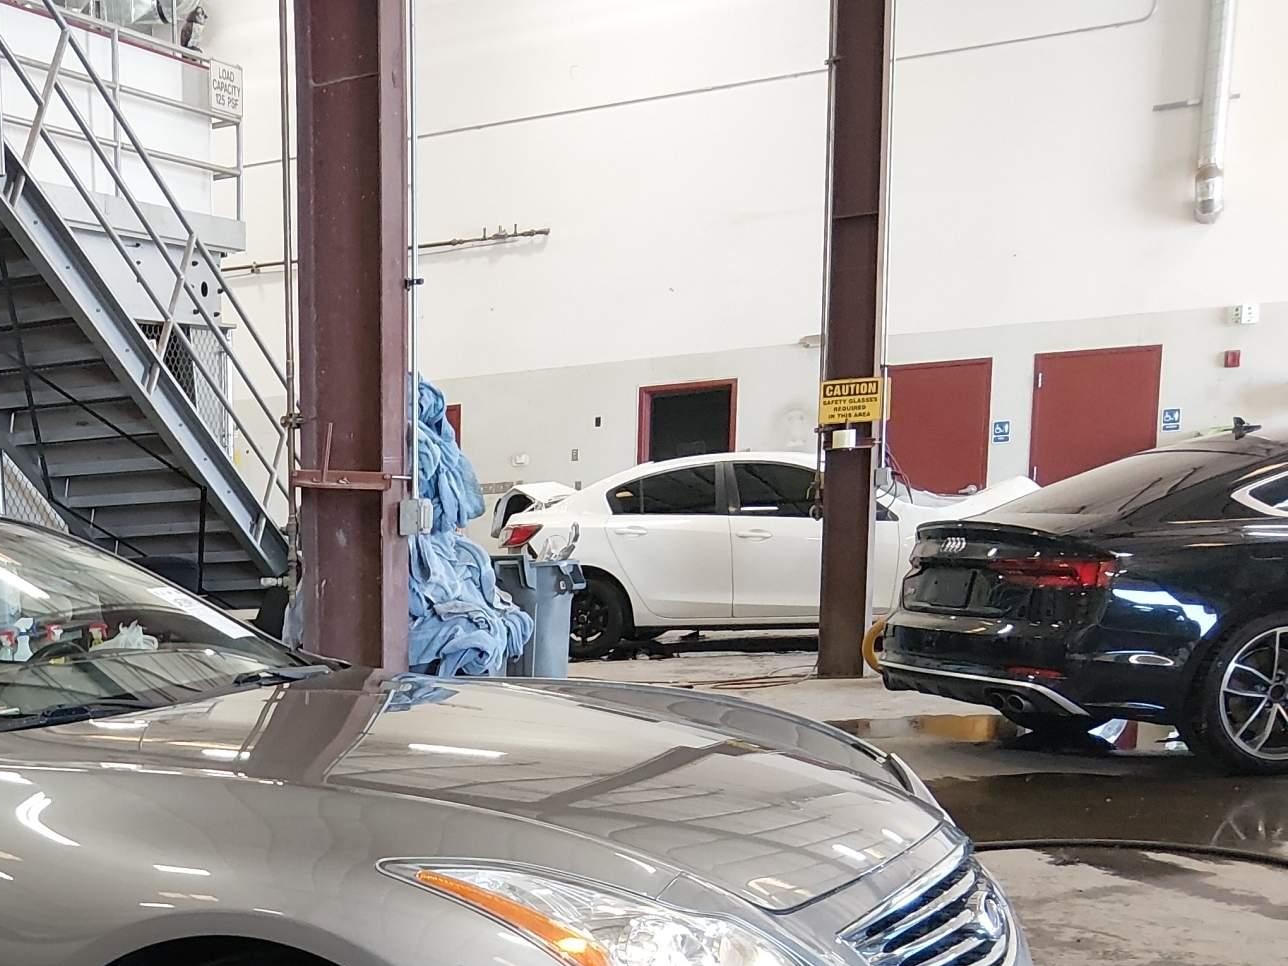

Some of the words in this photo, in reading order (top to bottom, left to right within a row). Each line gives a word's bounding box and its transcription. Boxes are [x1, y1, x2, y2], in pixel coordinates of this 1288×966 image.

[218, 67, 235, 83] LOAD
[212, 78, 241, 98] CAPACITY
[215, 93, 226, 106] 125
[227, 96, 239, 109] PSF
[825, 383, 877, 396] CAUTION
